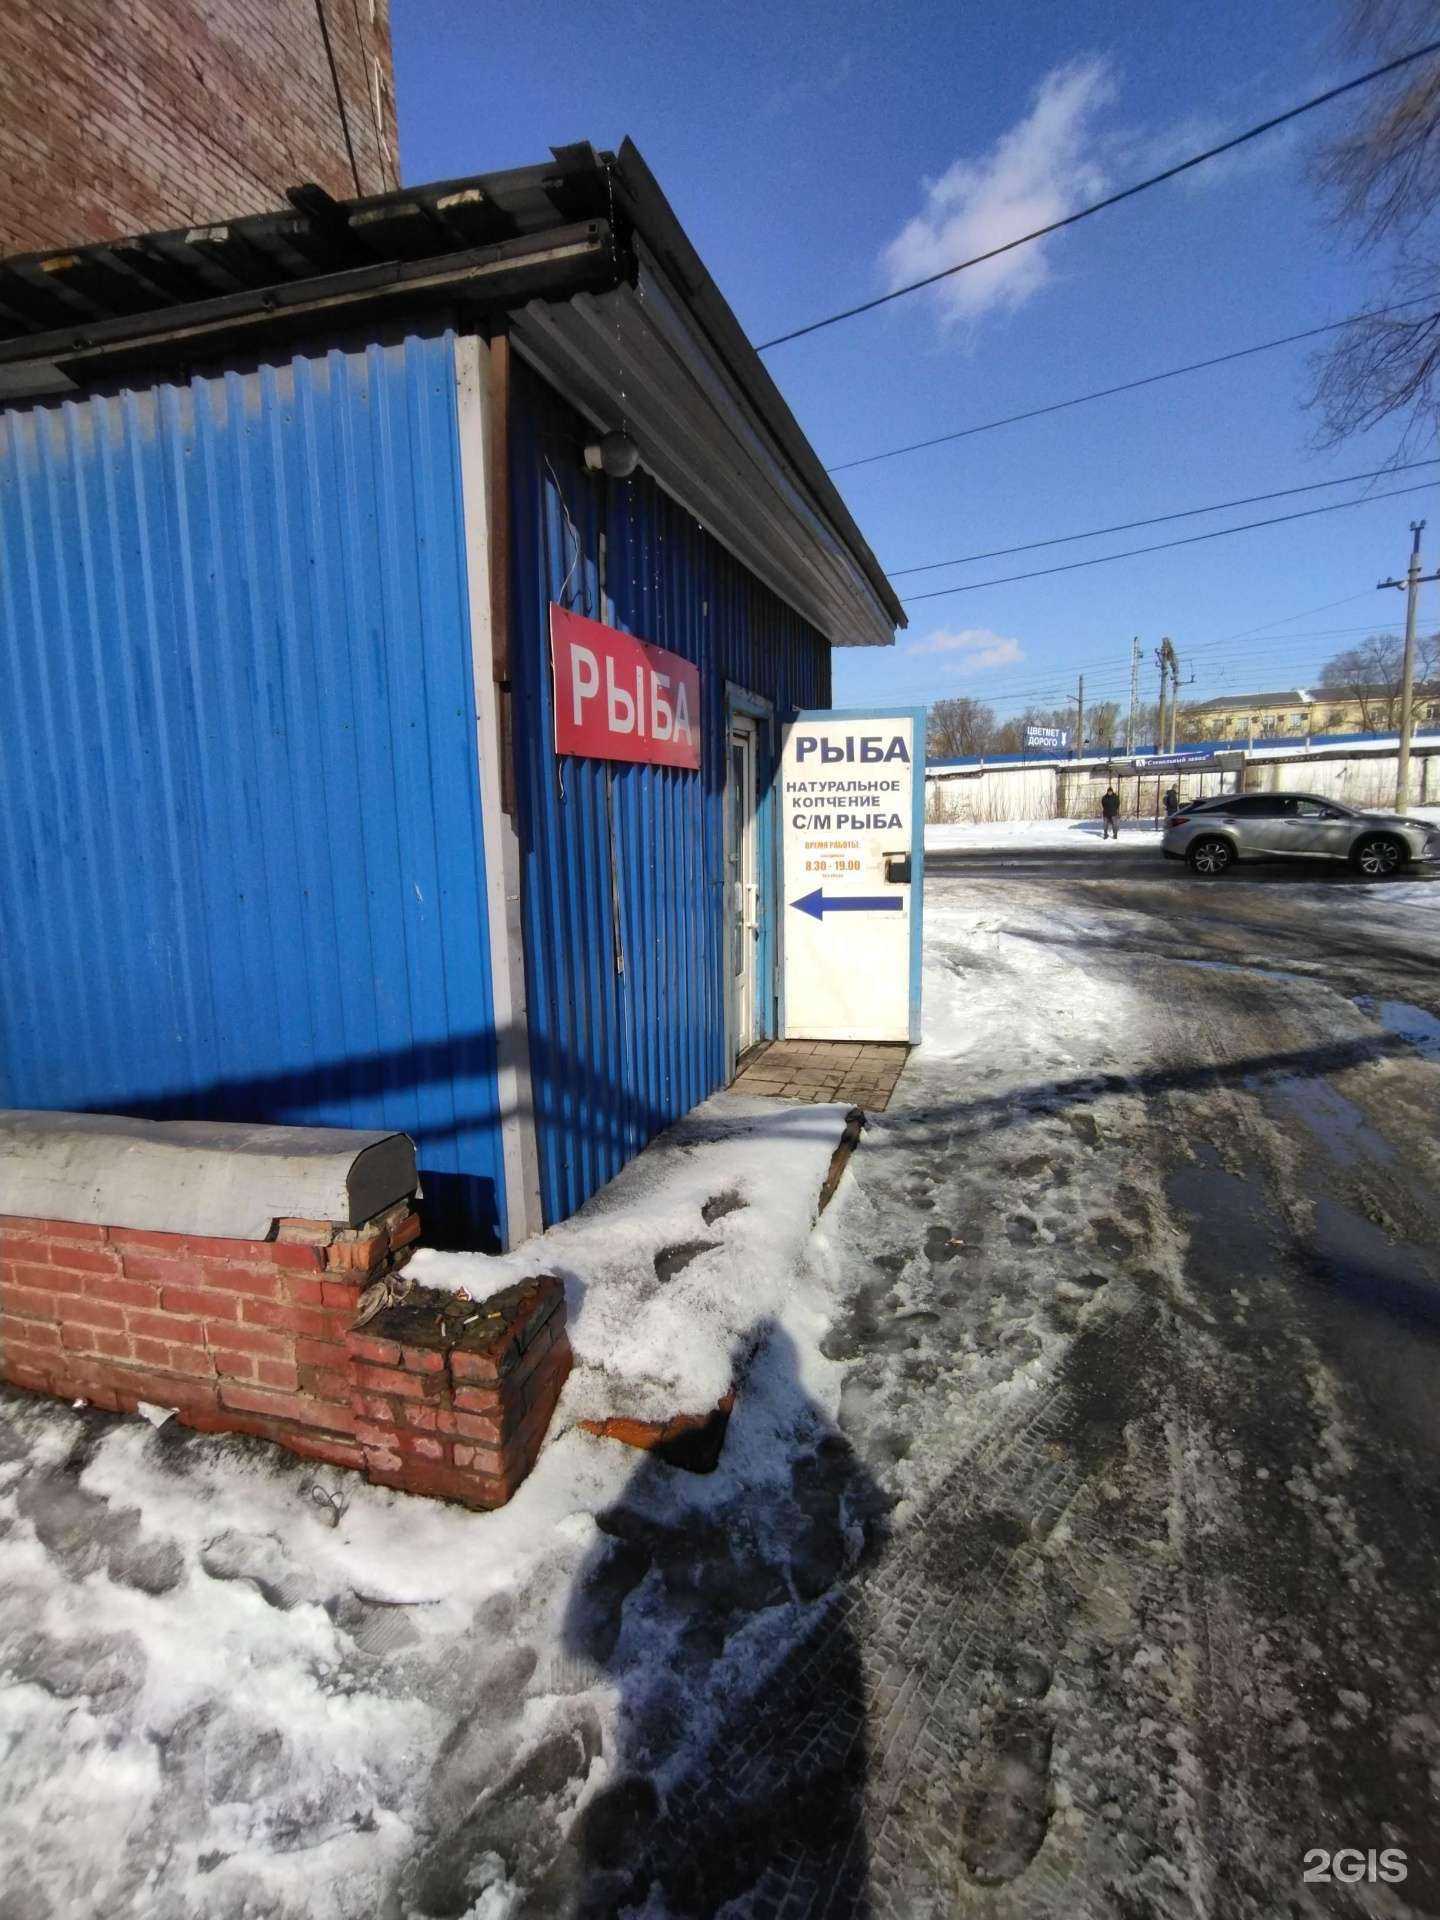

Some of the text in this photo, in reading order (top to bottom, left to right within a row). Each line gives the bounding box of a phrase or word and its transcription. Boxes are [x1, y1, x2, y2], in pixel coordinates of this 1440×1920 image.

[570, 643, 692, 746] РЫБА
[1028, 737, 1057, 748] ДОРОГО
[796, 736, 911, 763] РЫБА
[786, 780, 900, 792] НАТУРАЛЬНОЕ
[792, 796, 881, 808] КОПЧЕНИЕ
[792, 813, 903, 830] С/М РЫБА
[805, 860, 827, 871] 8.30
[835, 860, 861, 871] 19.00
